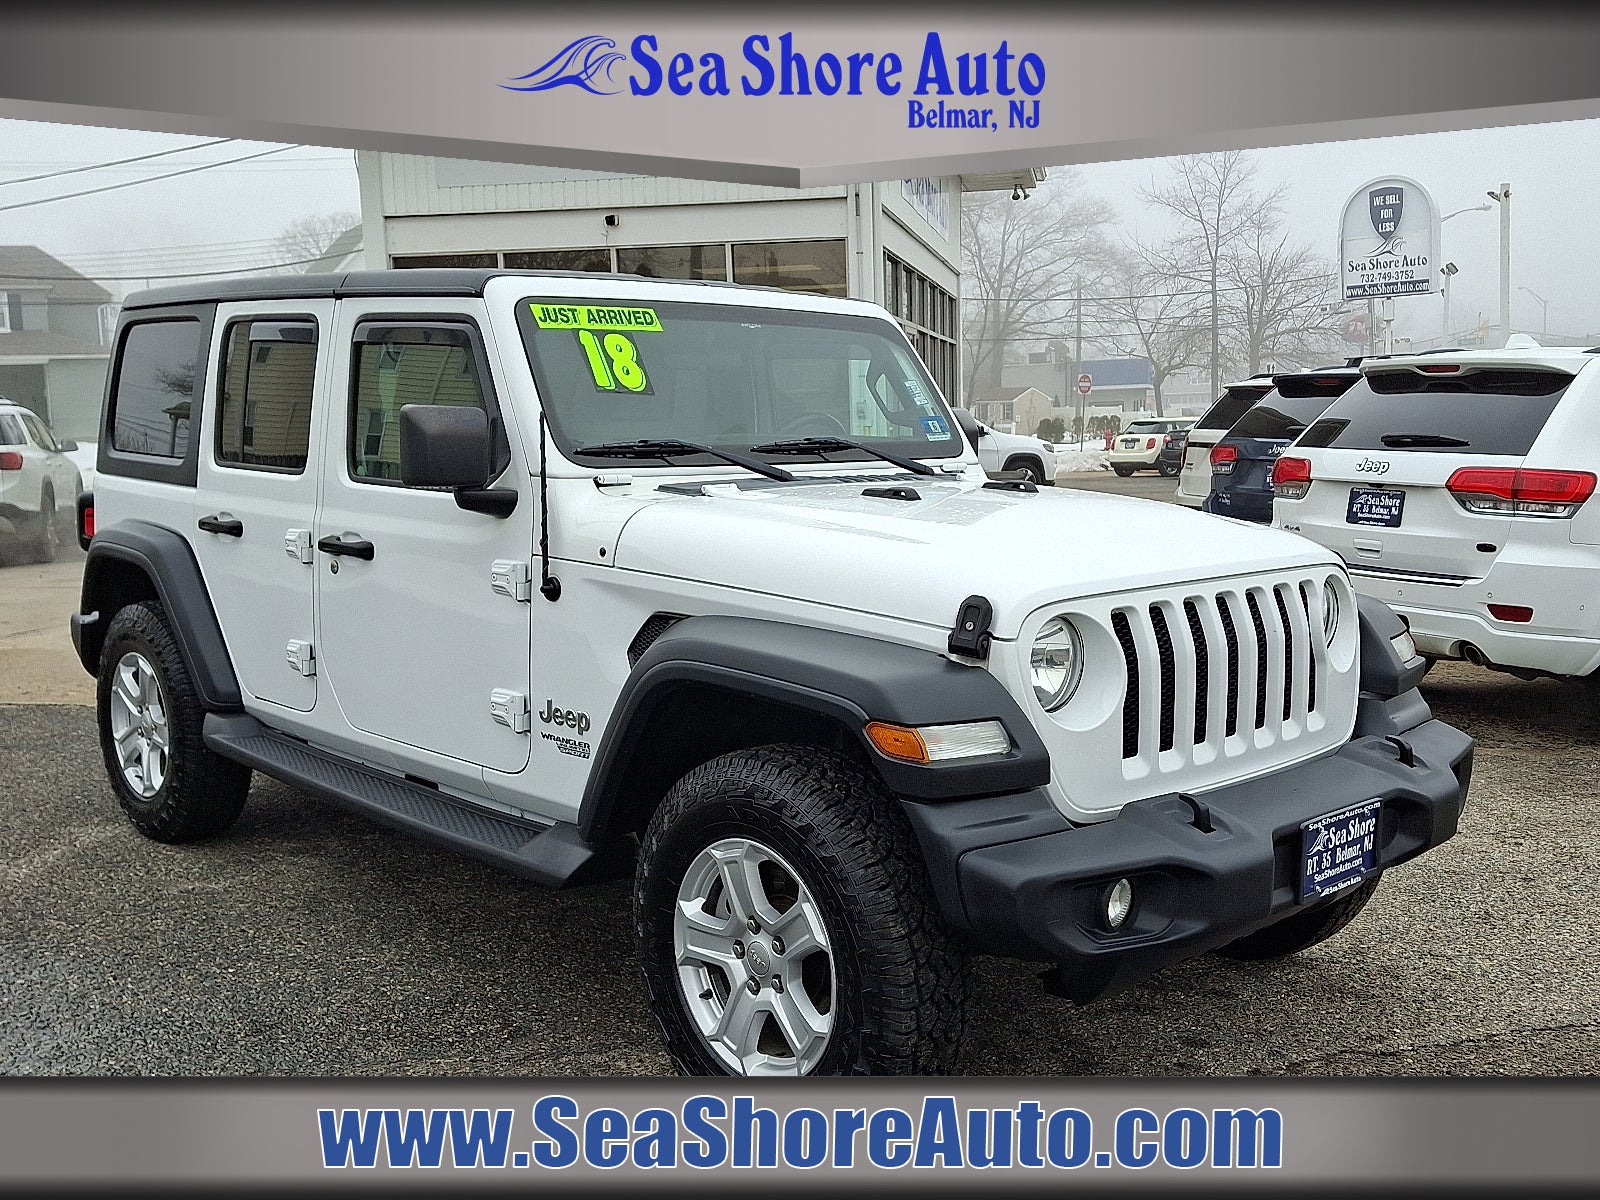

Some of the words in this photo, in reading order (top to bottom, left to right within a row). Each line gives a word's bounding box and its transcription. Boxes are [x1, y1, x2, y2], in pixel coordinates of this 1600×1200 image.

[1374, 196, 1384, 206] WE
[1386, 194, 1400, 205] SELL
[1381, 209, 1393, 219] FOR
[1379, 222, 1395, 232] LESS
[1348, 261, 1366, 272] Sea
[1369, 258, 1399, 271] Shore
[1402, 255, 1428, 268] Auto
[1361, 270, 1414, 283] 732-749-3752
[1346, 280, 1430, 297] www.SeaShoreAuto.com
[538, 307, 579, 324] JUST
[587, 309, 656, 326] ARRIVED
[579, 330, 647, 391] 18
[1356, 458, 1389, 475] Jeep
[539, 697, 590, 736] Jeep
[540, 731, 591, 749] WRANGLER
[1328, 827, 1347, 848] Sea
[1347, 817, 1376, 841] Shore
[1321, 850, 1332, 869] 35
[1336, 844, 1362, 864] Belmar,
[1363, 834, 1374, 852] NJ
[1314, 857, 1363, 883] SeaShoreAuto.com
